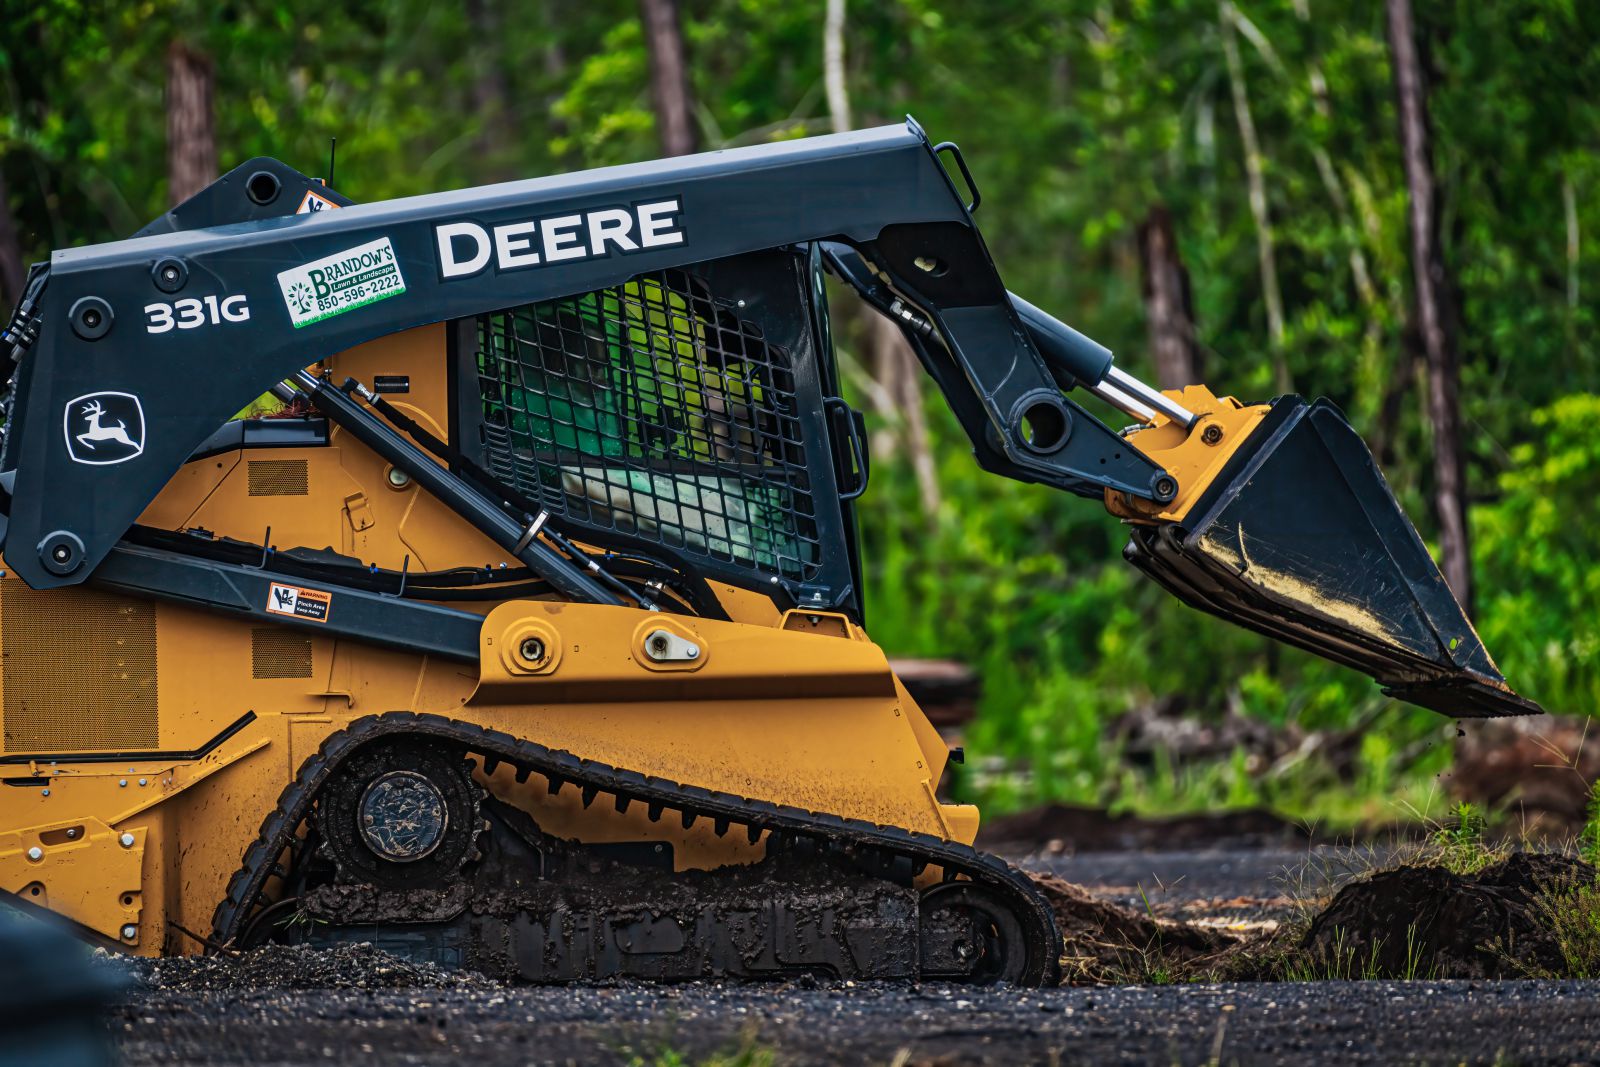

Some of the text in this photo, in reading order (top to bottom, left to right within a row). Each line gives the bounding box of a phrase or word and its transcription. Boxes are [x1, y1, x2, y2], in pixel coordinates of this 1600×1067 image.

[436, 200, 683, 278] DEERE
[308, 245, 393, 300] BRANDOW'S
[333, 280, 351, 290] Lawn
[358, 264, 394, 281] Landscape
[317, 274, 400, 312] 850-596-2222
[144, 294, 250, 334] 331G
[305, 592, 328, 600] WARNING
